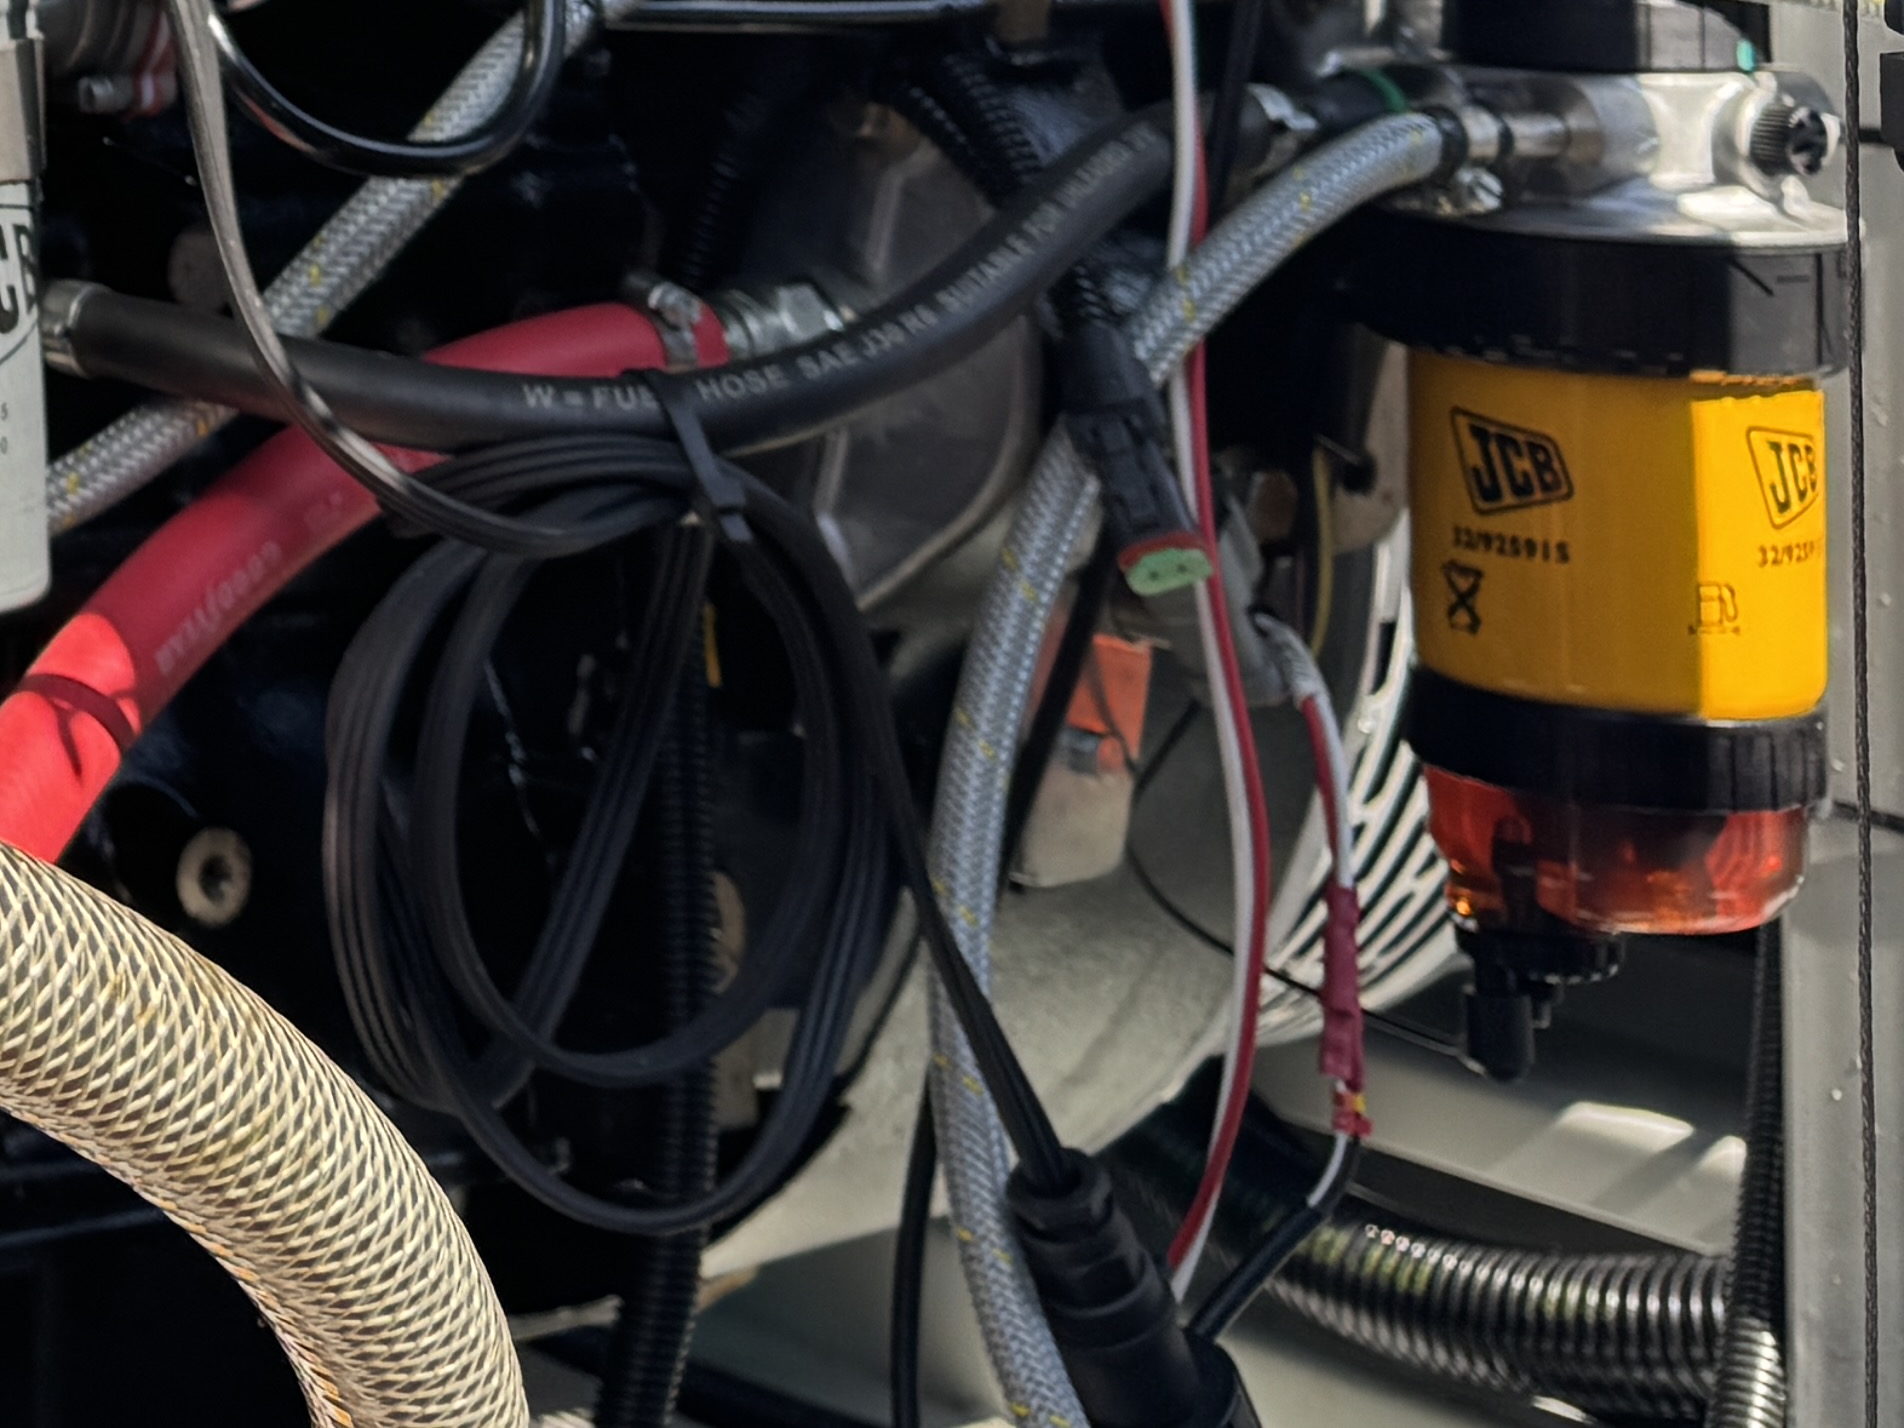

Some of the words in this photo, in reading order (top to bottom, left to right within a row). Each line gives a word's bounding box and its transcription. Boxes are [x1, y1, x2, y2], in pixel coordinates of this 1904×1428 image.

[697, 364, 790, 403] HOSE
[797, 341, 859, 379] SAE
[1469, 424, 1562, 502] JCB
